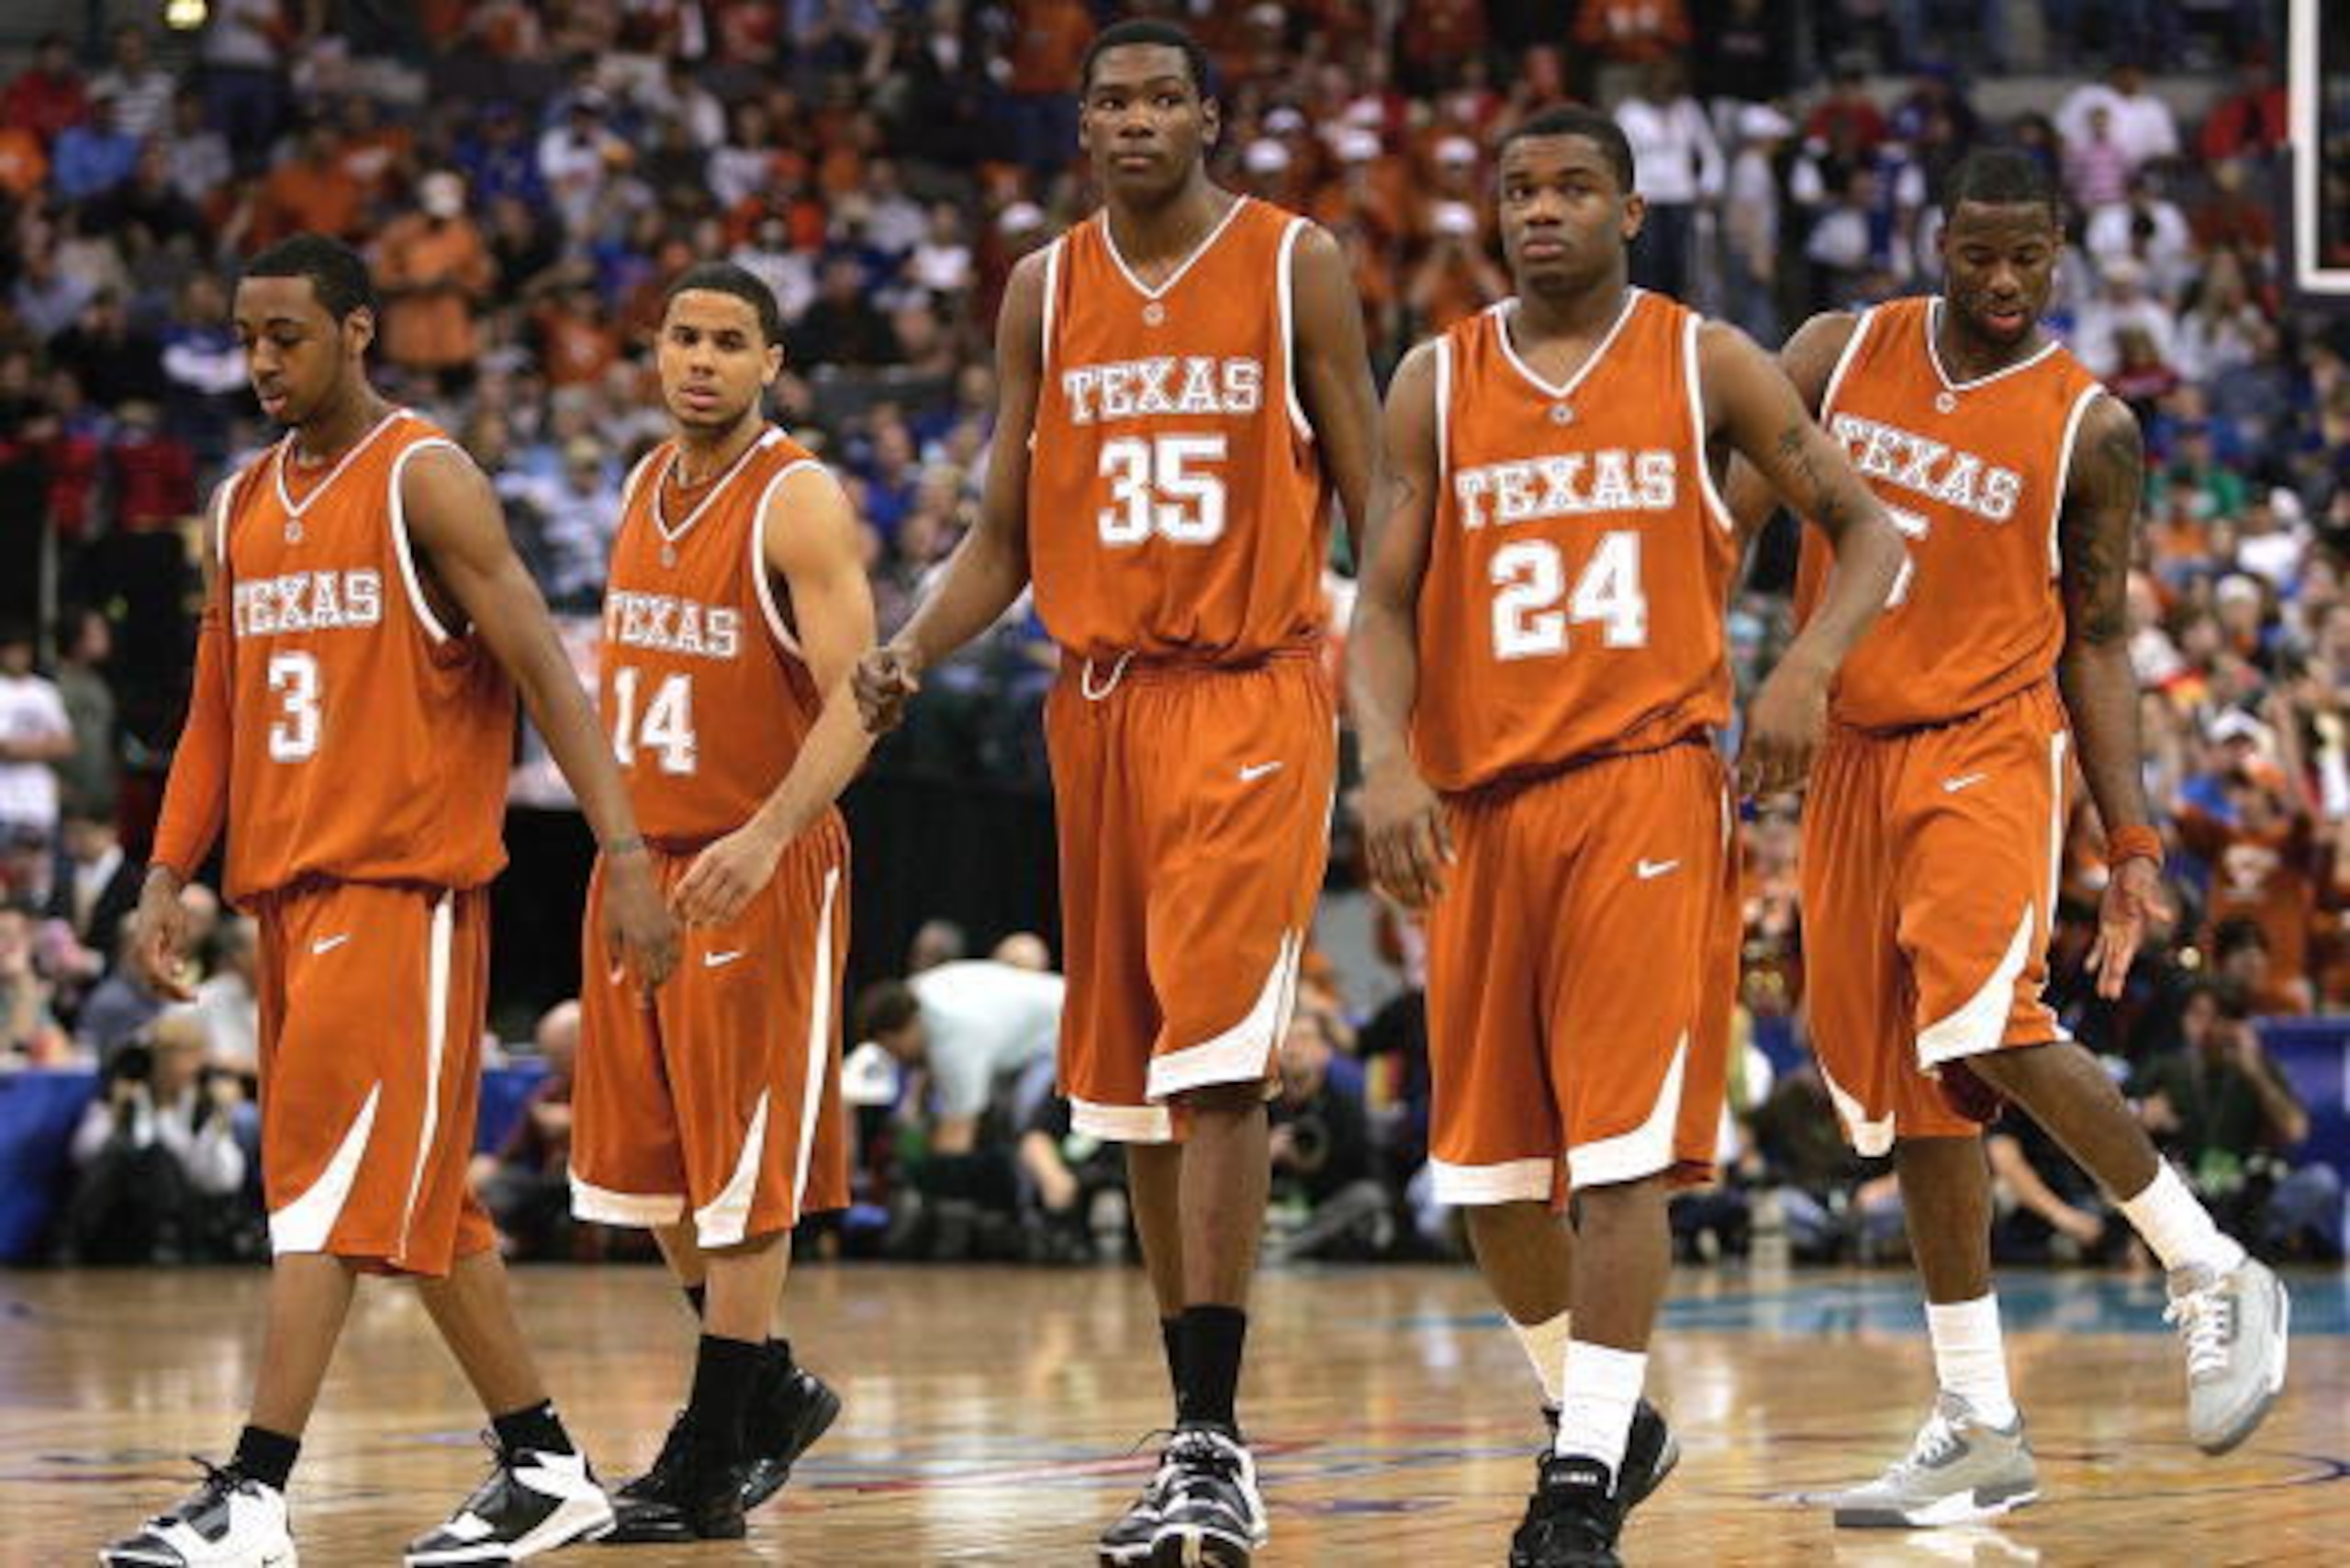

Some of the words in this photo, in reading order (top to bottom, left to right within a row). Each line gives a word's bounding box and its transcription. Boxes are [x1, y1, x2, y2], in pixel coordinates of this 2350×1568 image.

[1062, 357, 1264, 425] TEXAS
[1098, 434, 1228, 546] 35
[1455, 450, 1677, 530] TEXAS
[1489, 531, 1649, 660] 24
[268, 650, 320, 763] 3
[613, 666, 697, 773] 14
